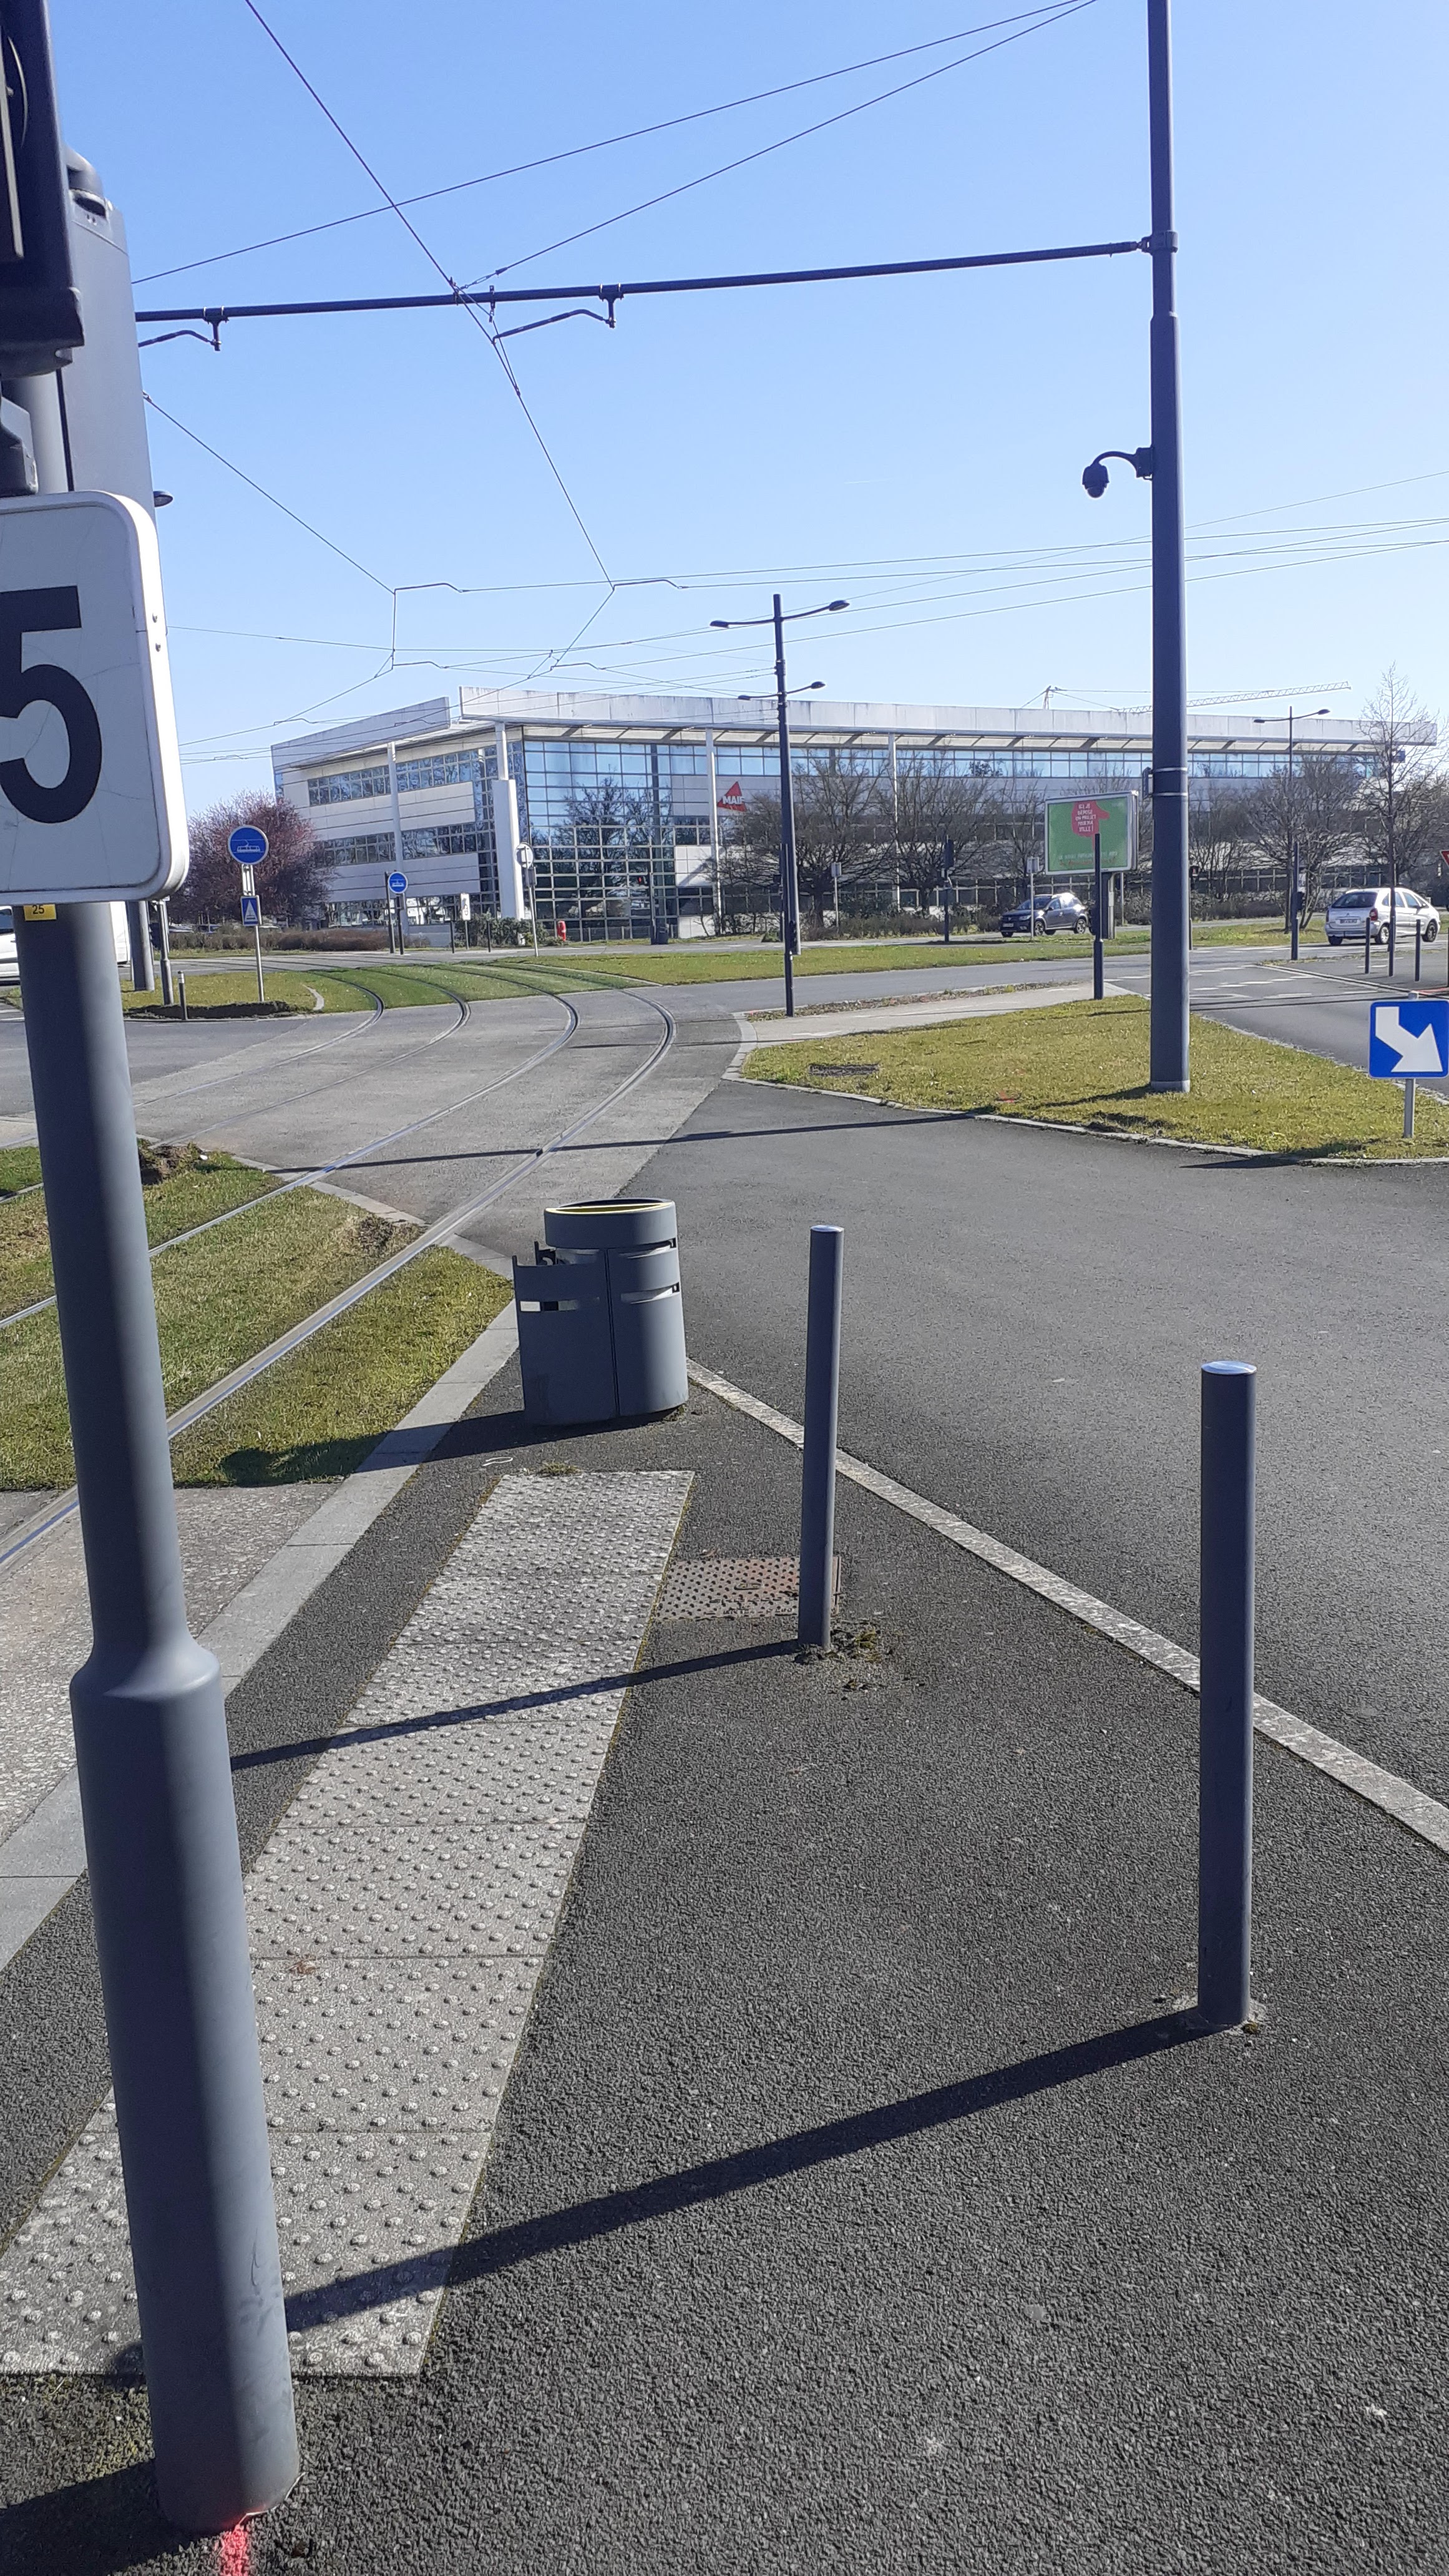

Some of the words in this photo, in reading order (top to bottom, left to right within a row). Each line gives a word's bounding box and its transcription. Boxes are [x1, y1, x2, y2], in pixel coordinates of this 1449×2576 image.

[0, 585, 102, 823] 5
[723, 796, 744, 804] MAIF
[32, 904, 45, 915] 25
